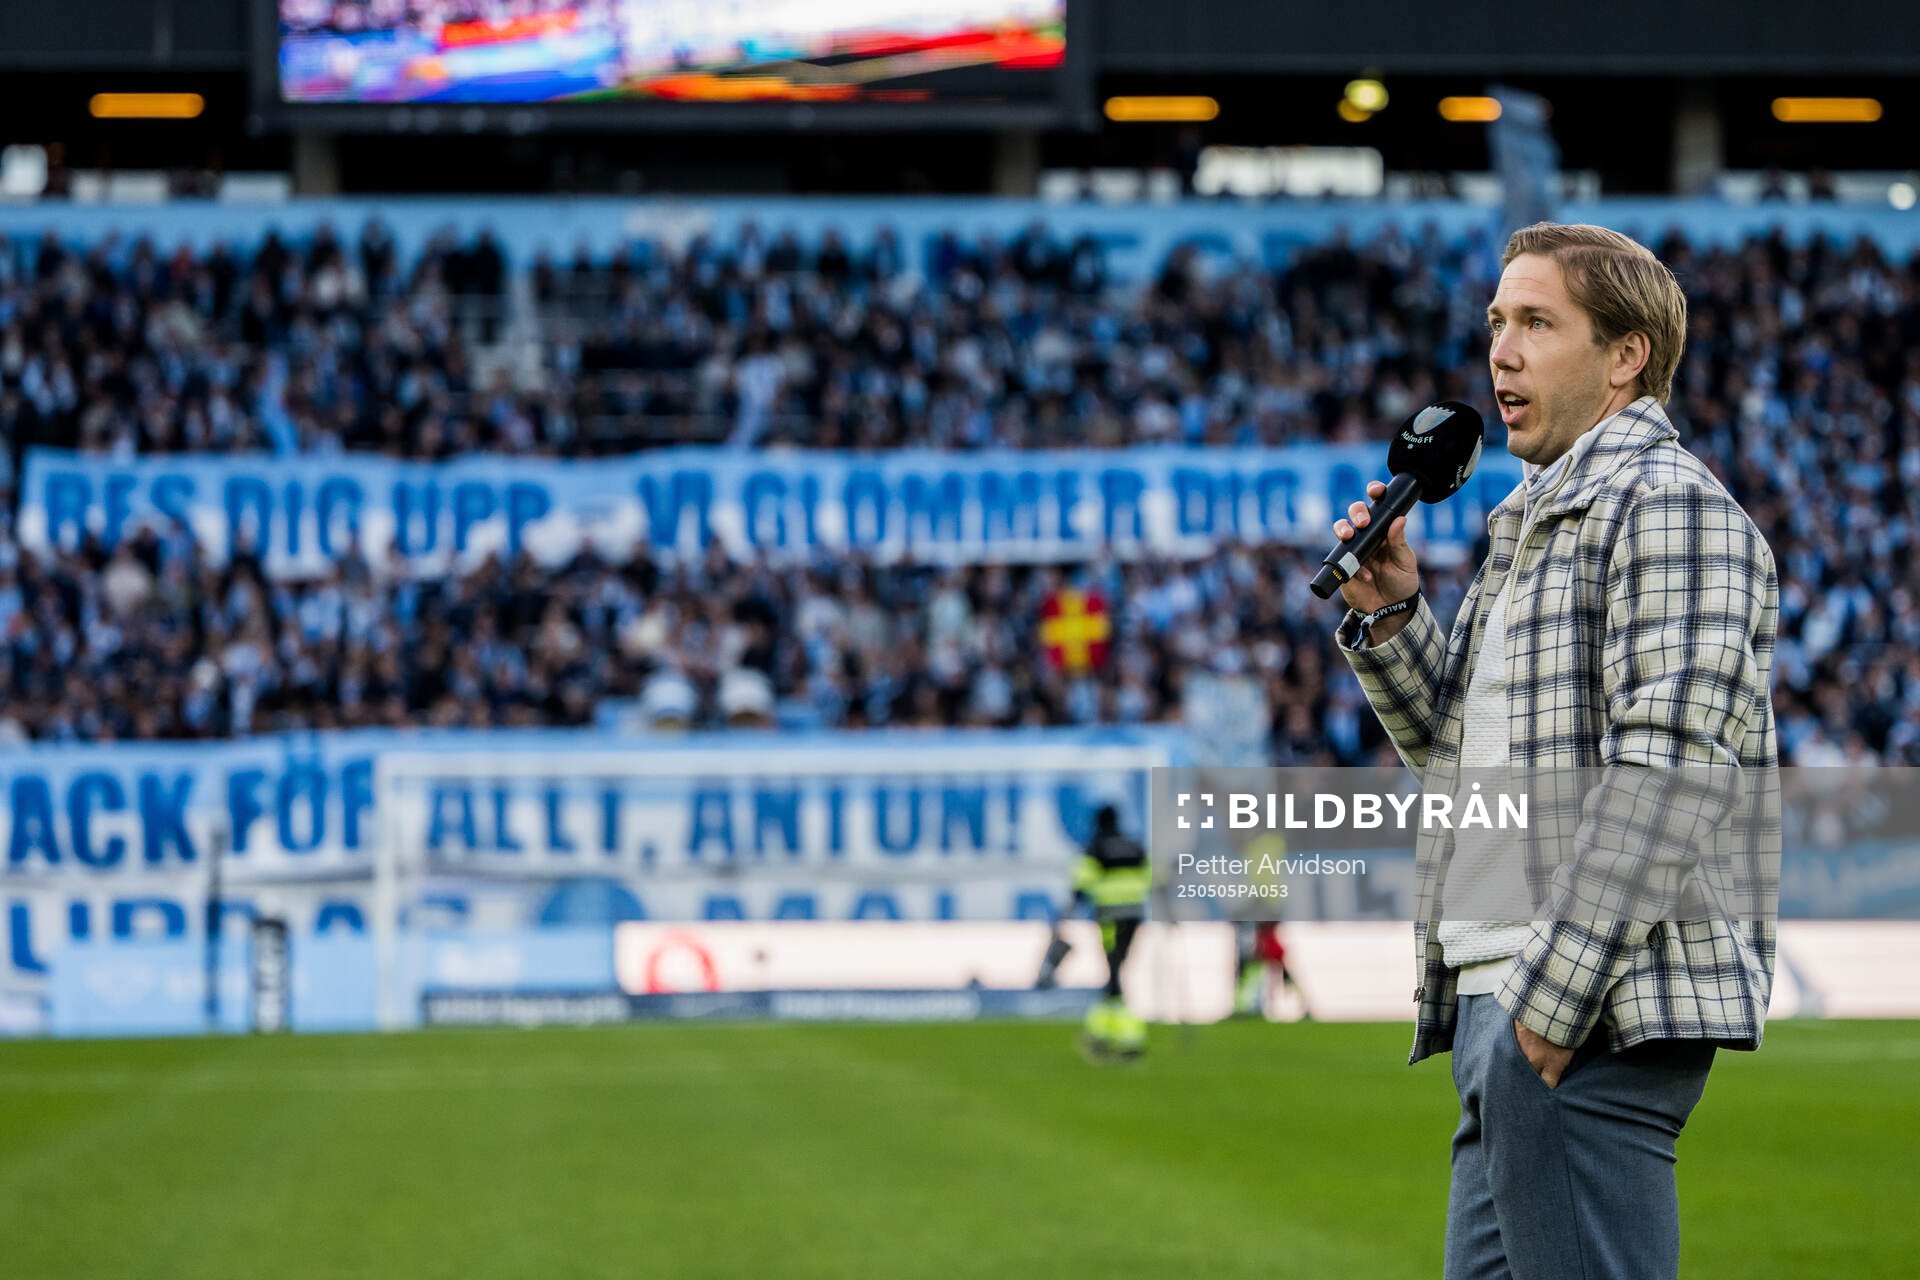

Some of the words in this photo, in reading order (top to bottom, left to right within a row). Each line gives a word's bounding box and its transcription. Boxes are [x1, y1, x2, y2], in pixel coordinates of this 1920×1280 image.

[1401, 431, 1423, 443] Malmö
[1424, 436, 1434, 444] FF
[393, 480, 551, 553] UPP
[636, 470, 712, 547] VI
